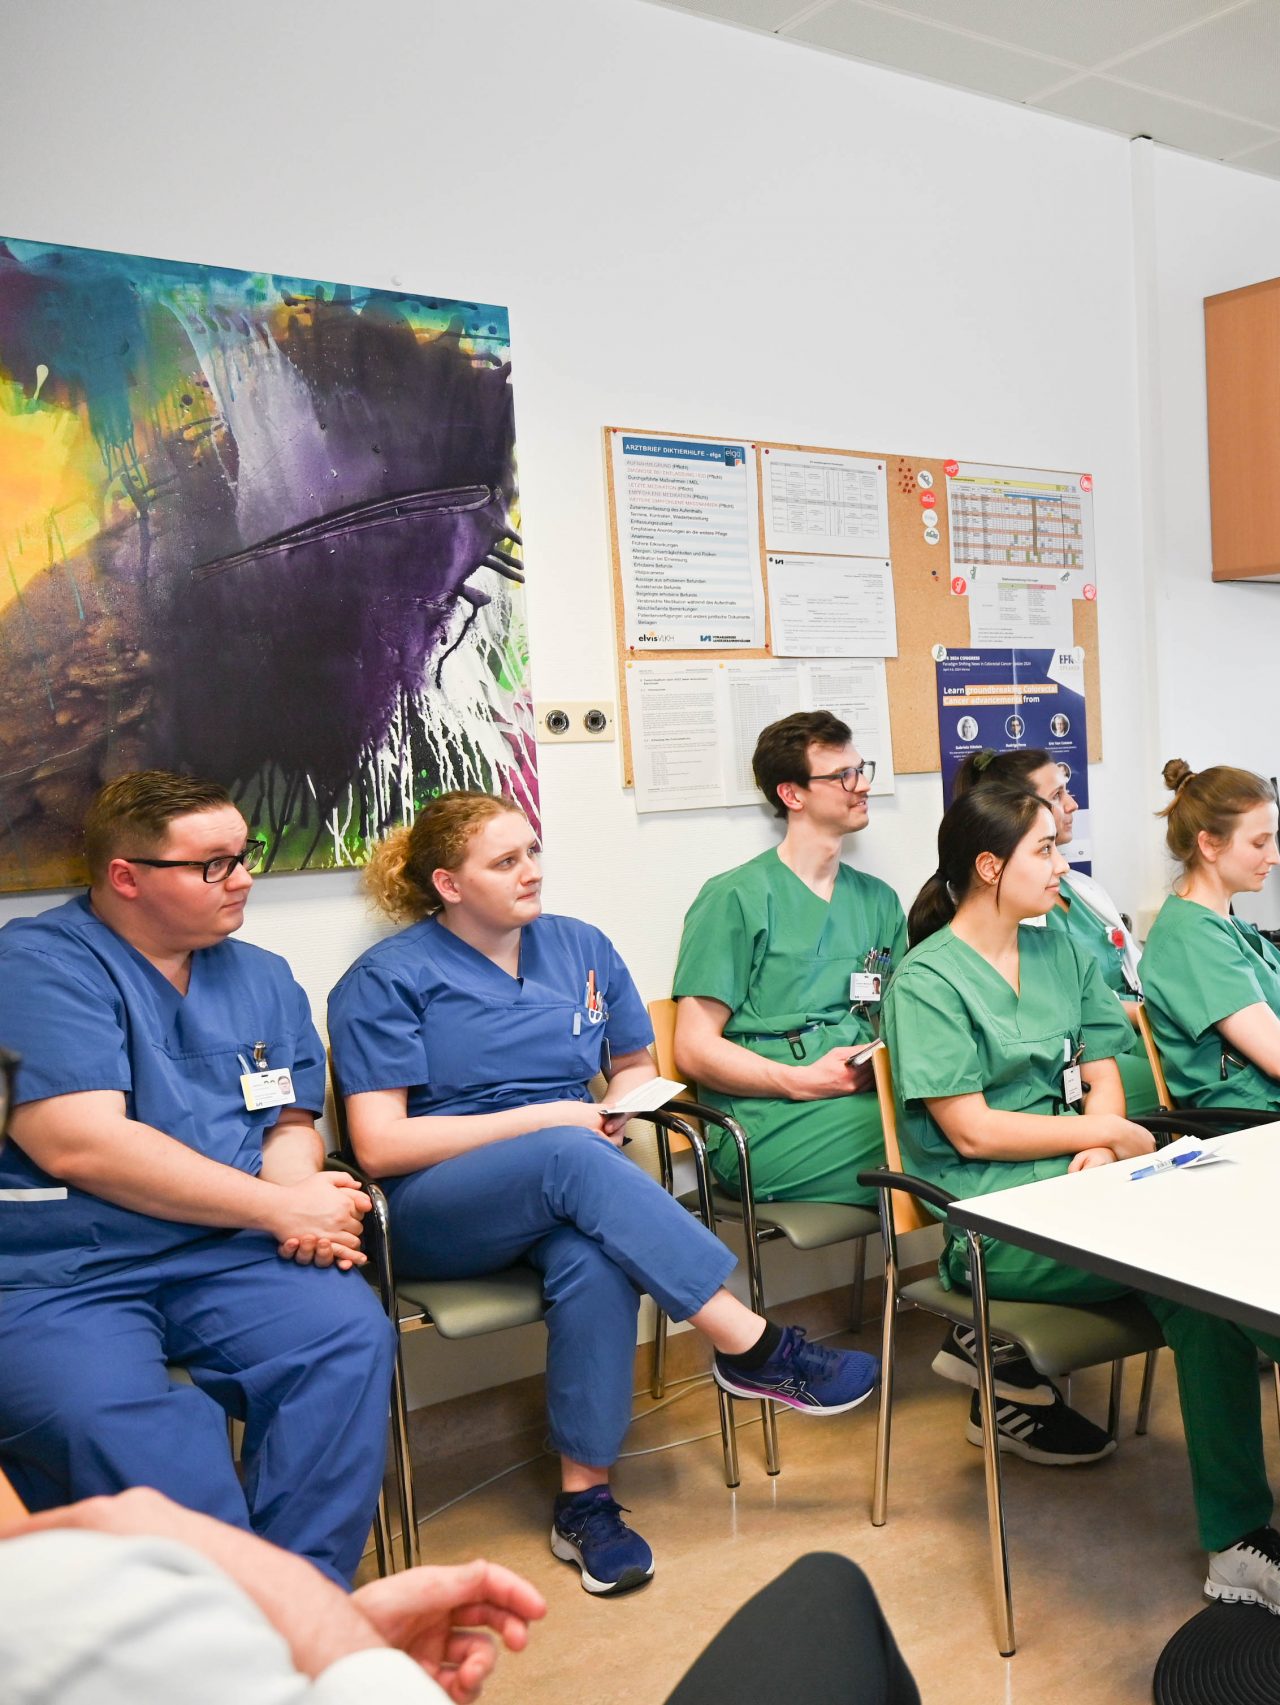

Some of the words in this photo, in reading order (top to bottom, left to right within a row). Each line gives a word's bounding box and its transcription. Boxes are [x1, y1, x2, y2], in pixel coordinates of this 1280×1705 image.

[625, 444, 661, 453] ARZTBRIEF
[663, 447, 705, 457] DIKTIERHILFE
[725, 450, 741, 459] elga
[944, 686, 965, 695] Learn
[1023, 695, 1040, 703] from
